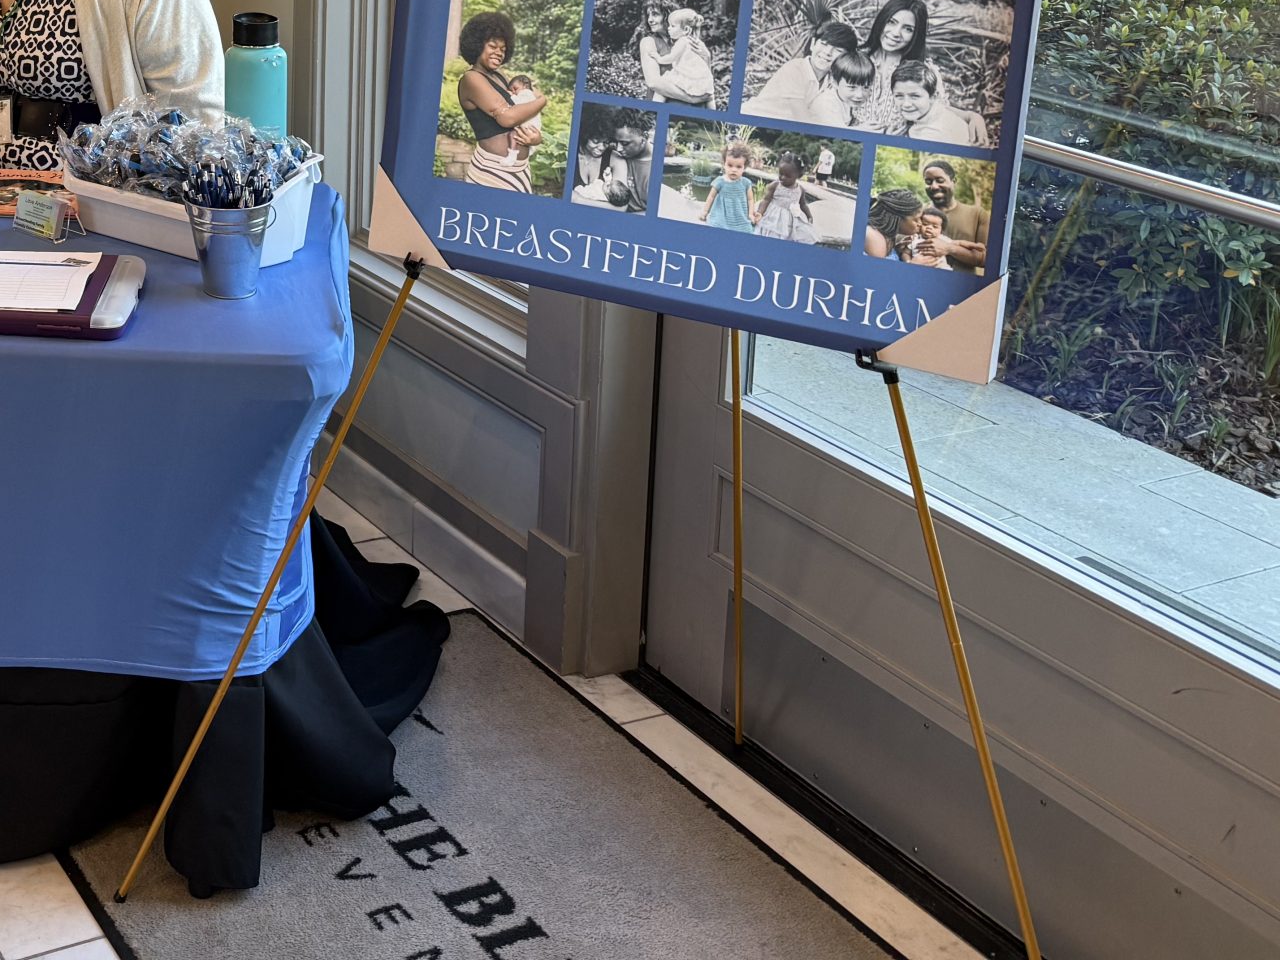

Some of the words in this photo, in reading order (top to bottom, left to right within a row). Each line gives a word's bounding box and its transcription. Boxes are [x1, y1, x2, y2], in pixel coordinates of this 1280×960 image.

[436, 206, 717, 293] BREASTFEED
[367, 781, 470, 872] HE
[432, 876, 558, 960] BL
